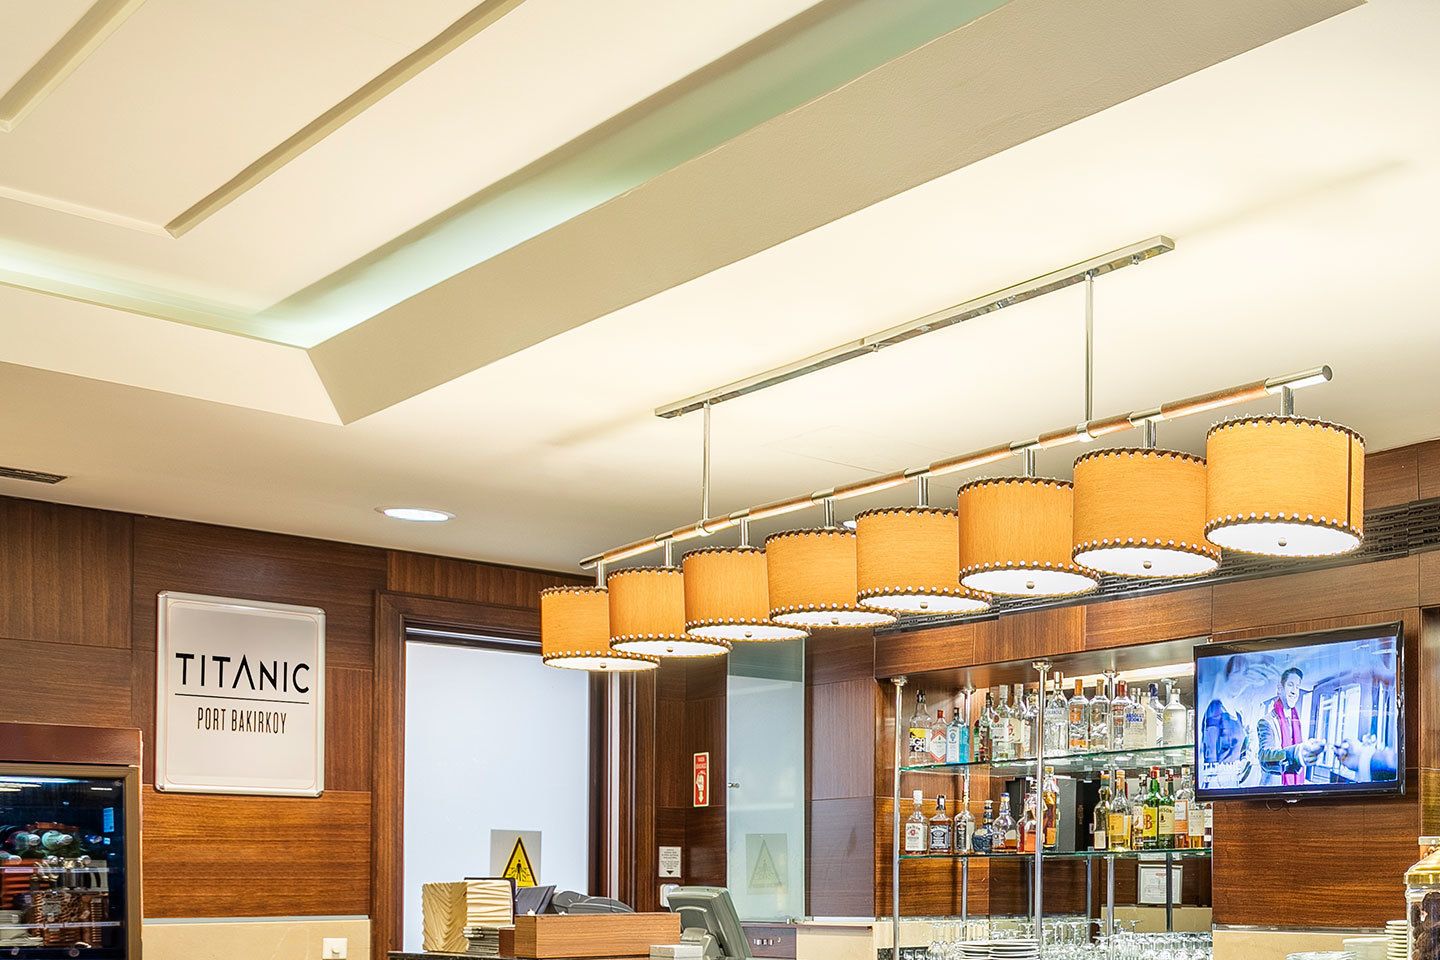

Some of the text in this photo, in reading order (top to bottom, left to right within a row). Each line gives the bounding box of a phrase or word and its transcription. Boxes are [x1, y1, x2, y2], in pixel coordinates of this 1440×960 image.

[175, 652, 310, 694] TITANIC
[197, 706, 287, 734] PORT BAKIRKOY
